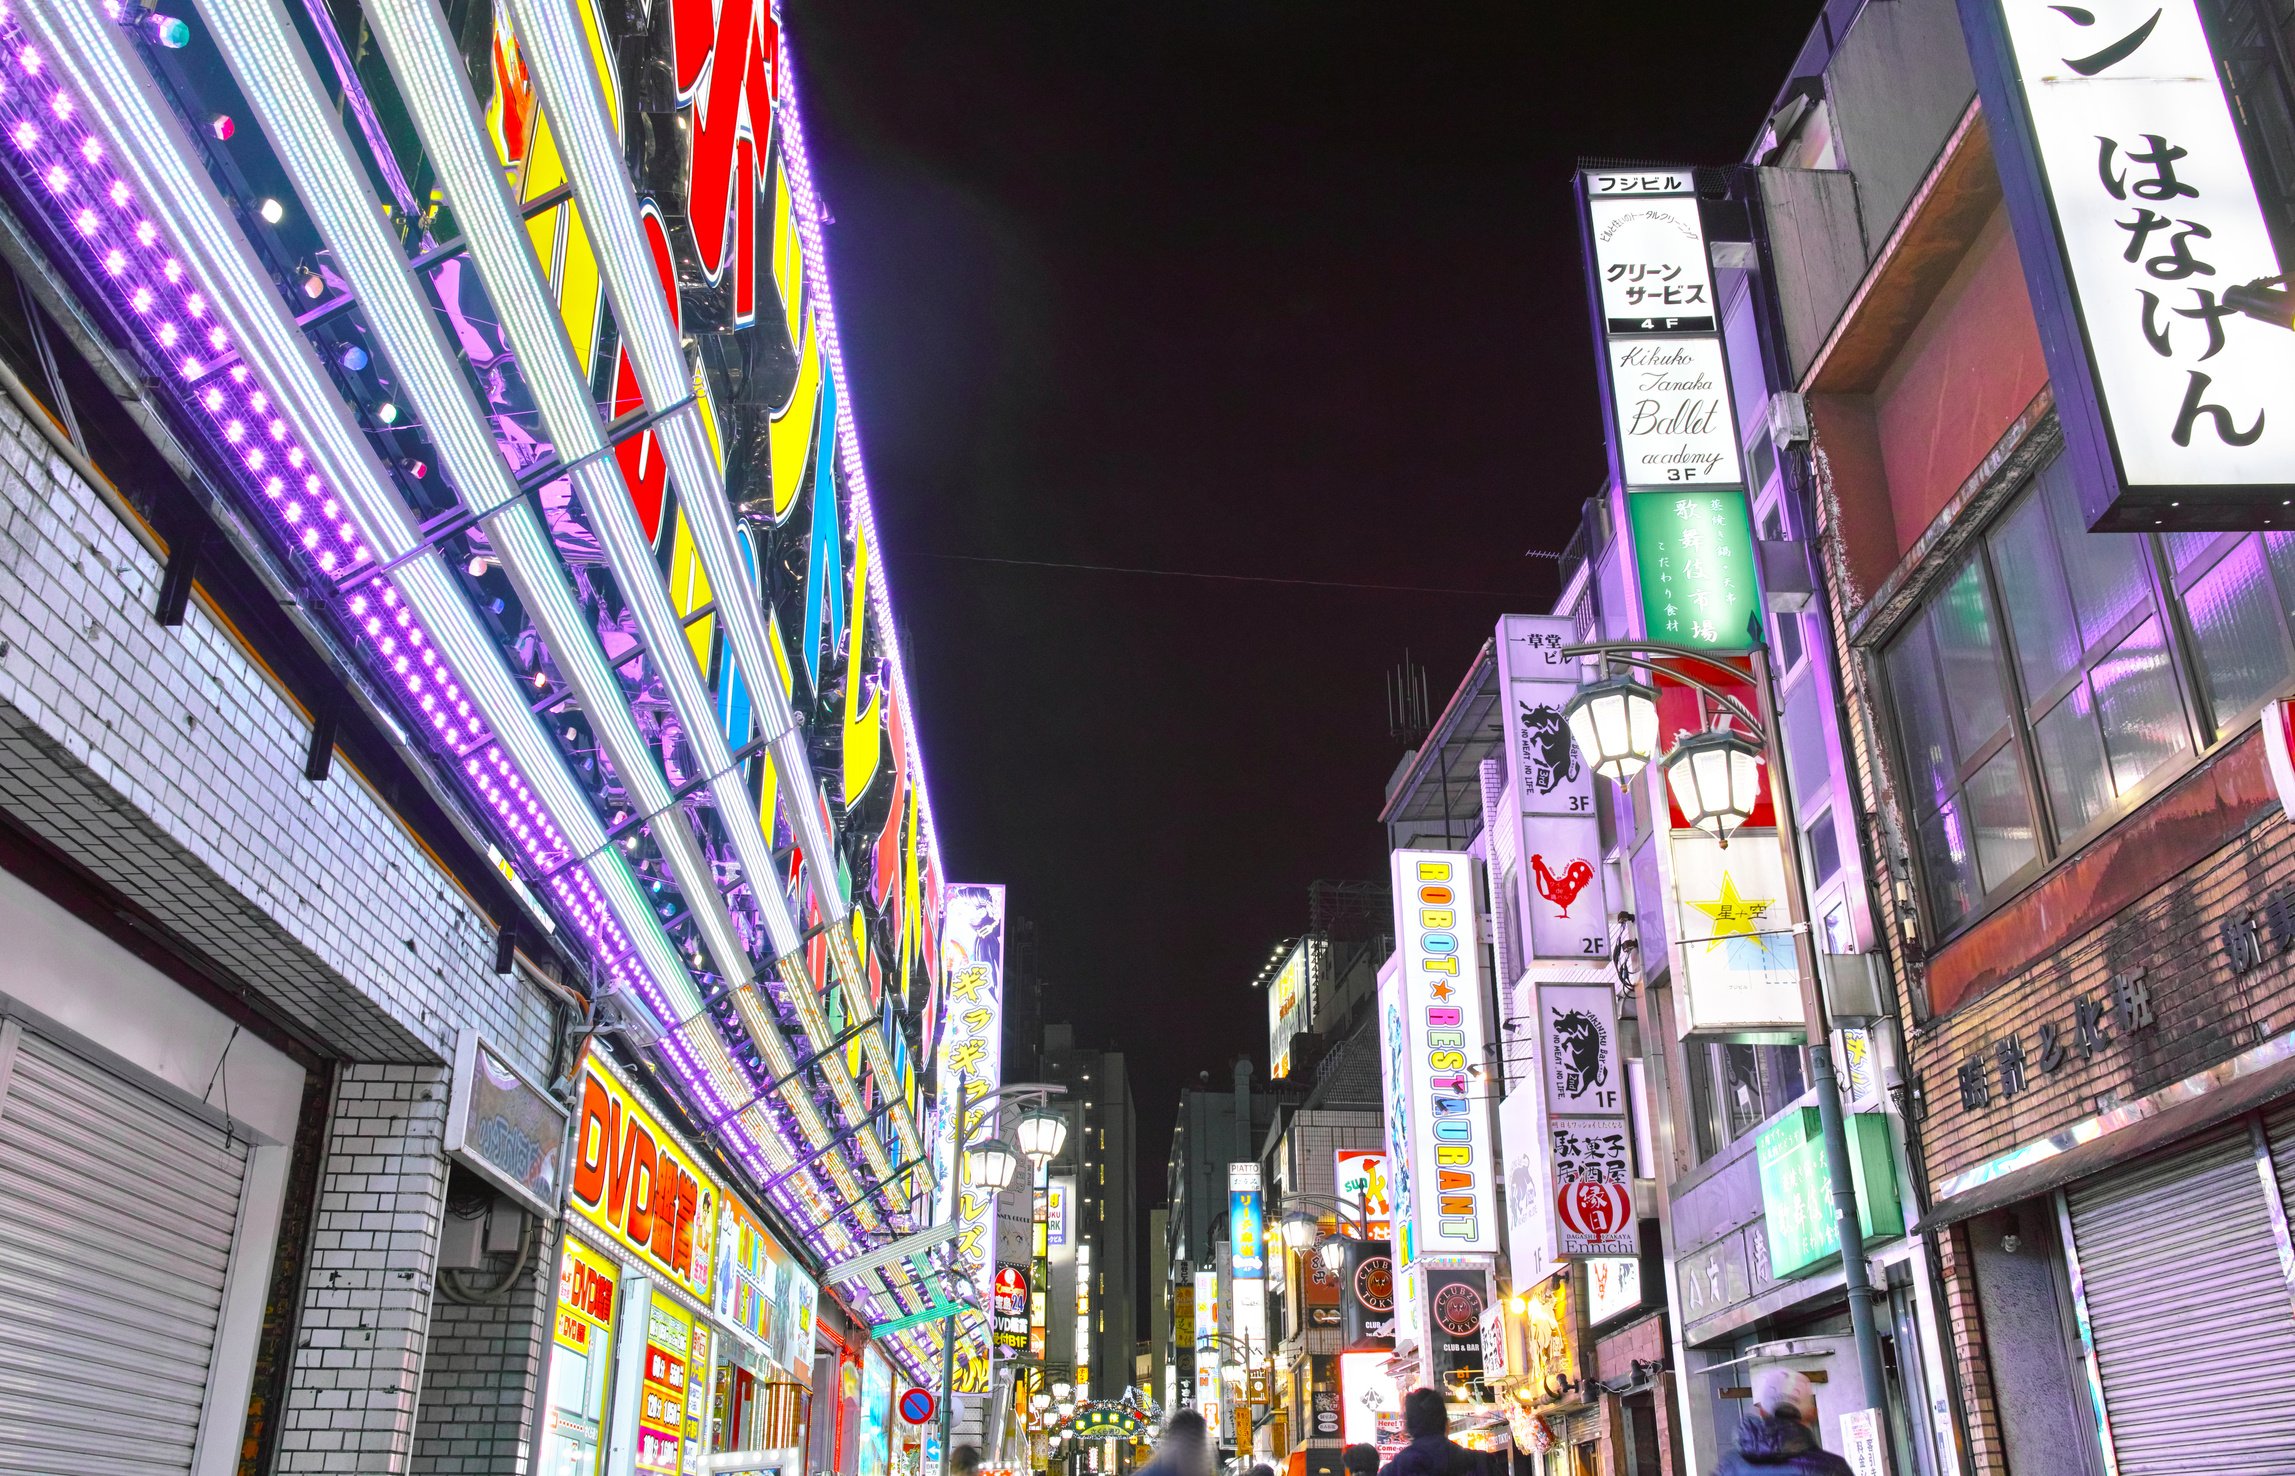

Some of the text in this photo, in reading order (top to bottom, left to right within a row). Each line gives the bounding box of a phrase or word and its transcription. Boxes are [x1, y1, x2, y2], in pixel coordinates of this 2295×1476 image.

[1598, 176, 1683, 192] フジビル
[1606, 263, 1683, 283] クリーン
[1625, 284, 1709, 305] サービス
[2093, 134, 2265, 447] はなけん
[1620, 346, 1696, 368] Kikuko
[1638, 372, 1713, 391] Tanaka
[1625, 398, 1719, 437] Ballet
[1641, 450, 1725, 475] academy
[1666, 469, 1697, 481] 3F
[1672, 498, 1718, 644] 歌舞伎市場
[1657, 541, 1680, 633] こだわり食材
[1510, 633, 1562, 649] 一草堂
[1544, 651, 1573, 665] ビル
[1568, 796, 1590, 811] 3F
[1582, 938, 1604, 954] 2F
[1553, 1034, 1560, 1044] NO
[1417, 861, 1478, 1242] ROBOT RESTAURANT
[1595, 1091, 1616, 1108] 1F
[949, 966, 993, 1260] ギラギラガールズ
[1553, 1130, 1625, 1160] 駄菓子
[573, 1070, 698, 1283] DVD鑑賞
[1231, 1164, 1259, 1172] PIATTO
[1557, 1160, 1628, 1185] 居酒屋
[1580, 1185, 1608, 1231] 縁日
[1565, 1240, 1634, 1254] Ennichi
[1438, 1287, 1478, 1305] CLUB23
[1441, 1315, 1478, 1332] TOKYO
[1443, 1344, 1460, 1352] CLUB
[1466, 1344, 1480, 1352] BAR
[1457, 1365, 1470, 1379] B1
